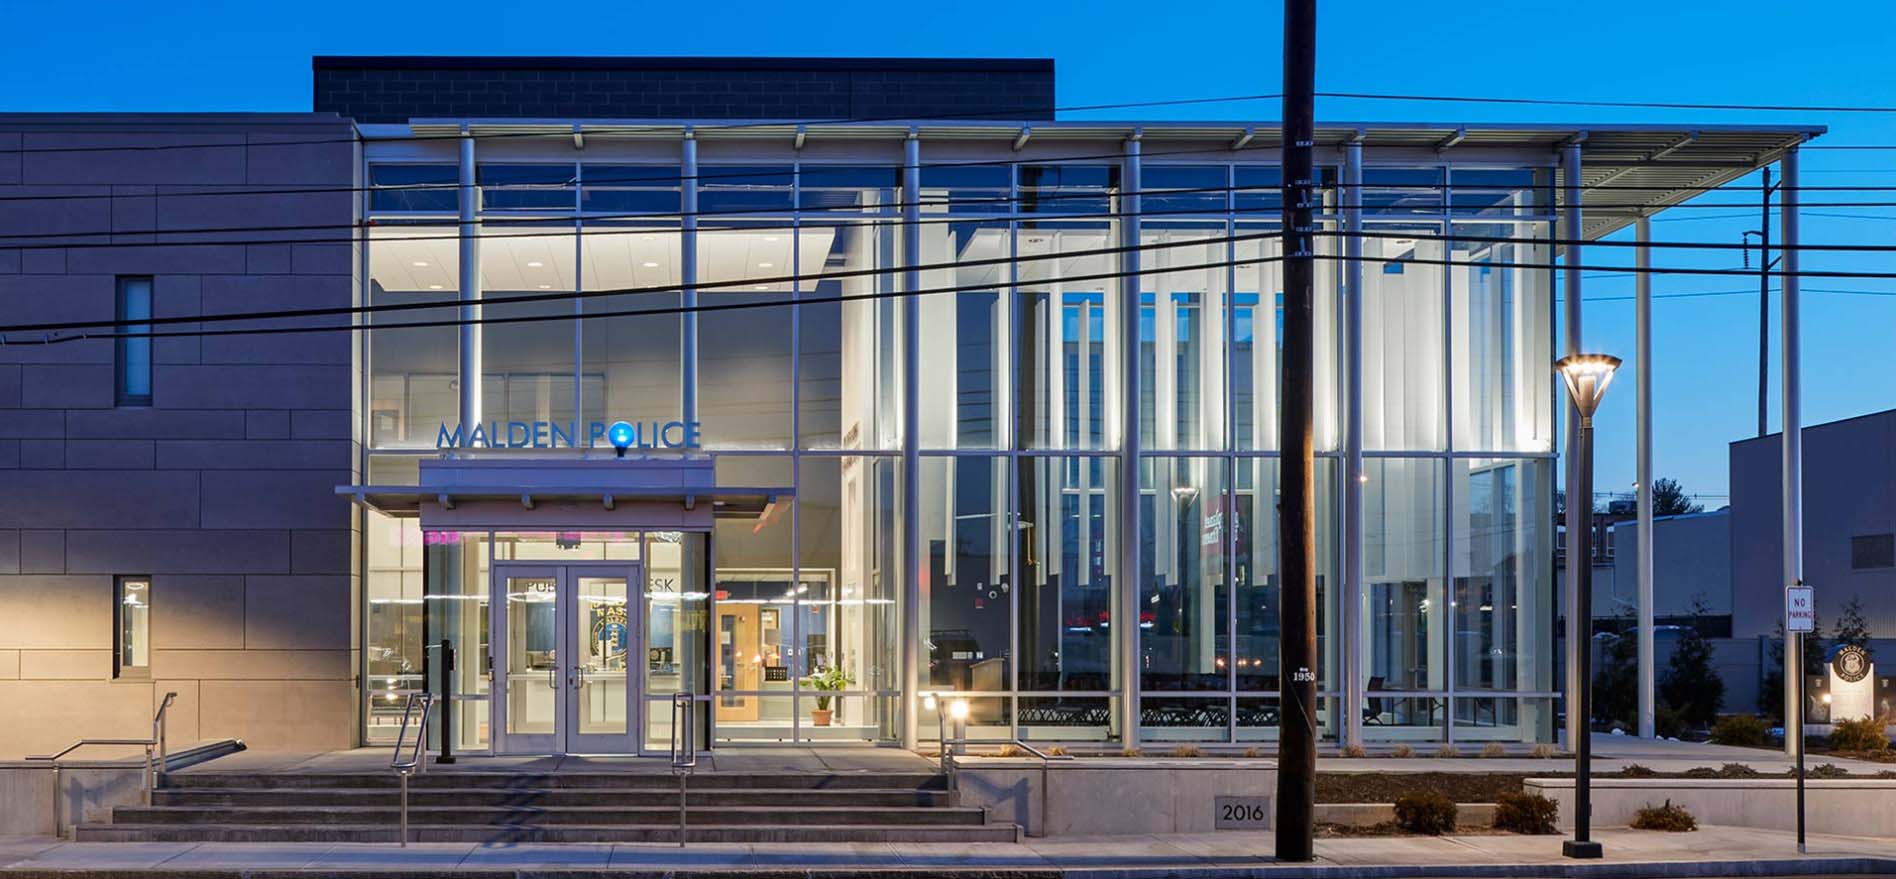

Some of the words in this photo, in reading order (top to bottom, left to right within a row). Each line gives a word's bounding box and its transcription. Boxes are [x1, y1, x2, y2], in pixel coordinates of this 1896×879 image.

[436, 421, 575, 448] MALDEN
[589, 421, 701, 448] PLICE
[1794, 597, 1806, 608] NO
[1789, 610, 1812, 619] PARKING
[1223, 804, 1264, 821] 2016
